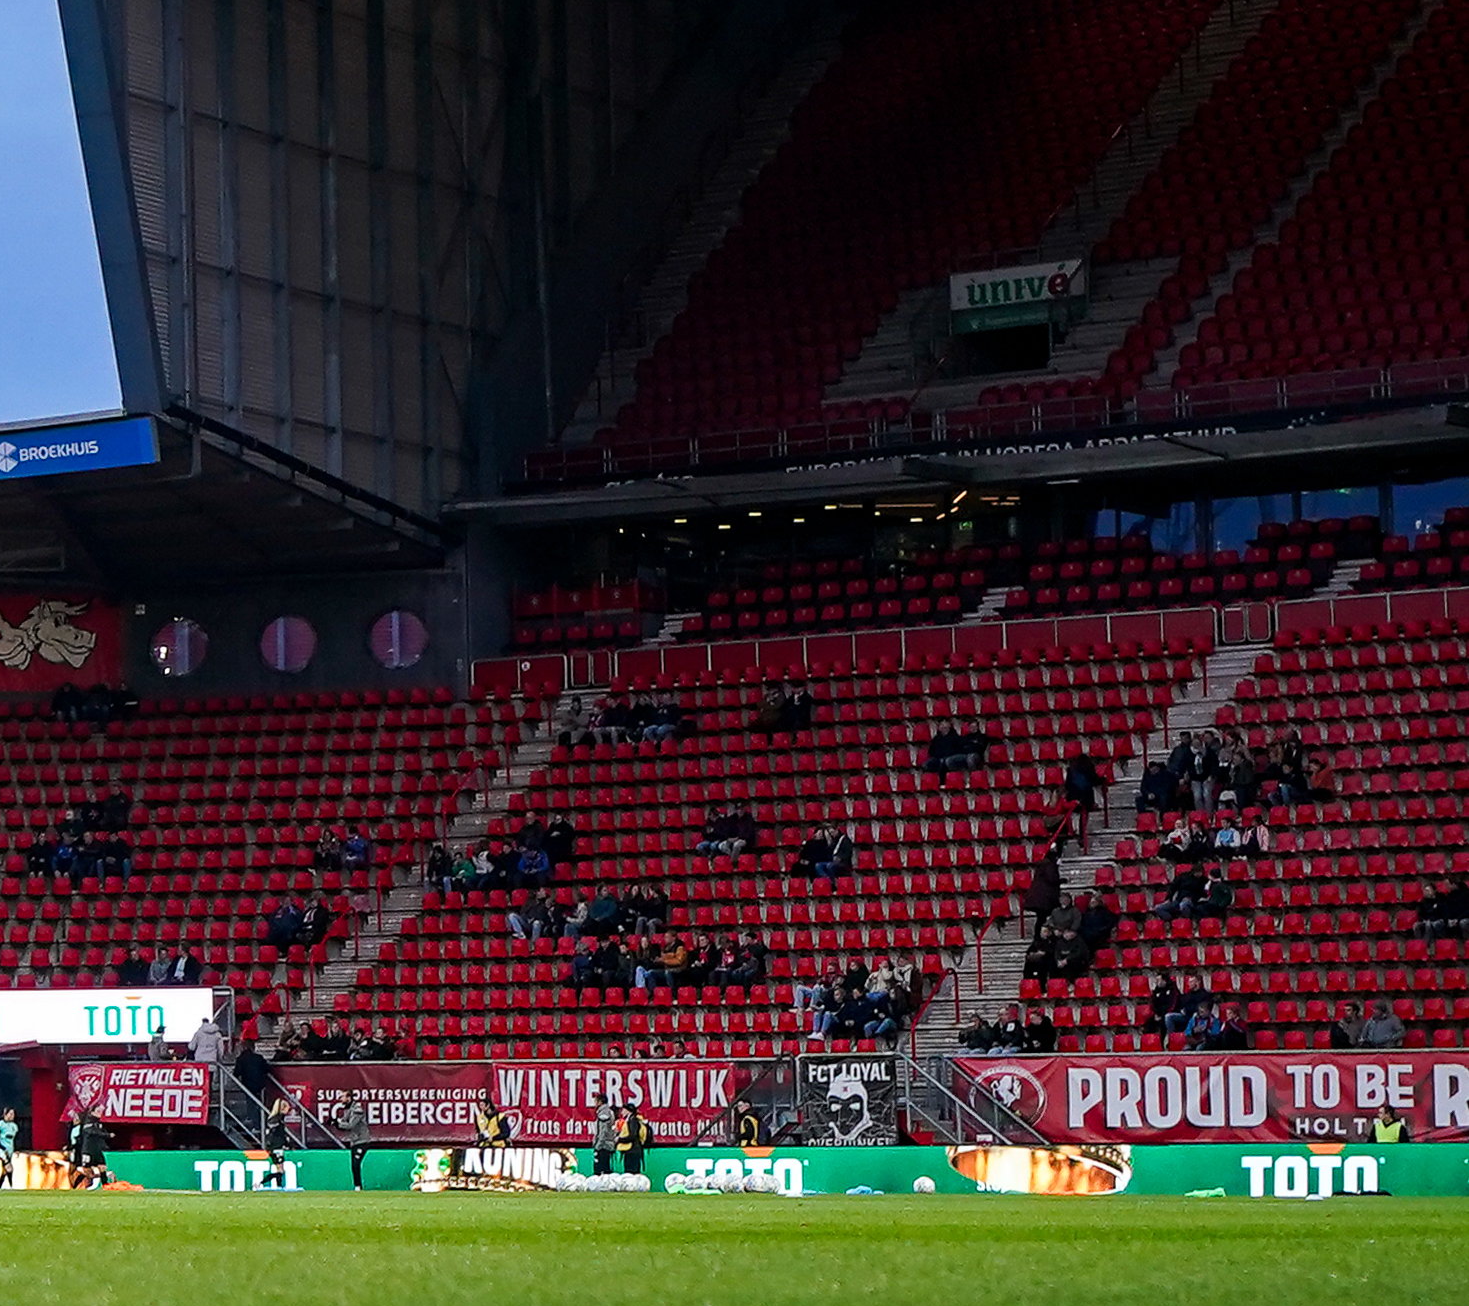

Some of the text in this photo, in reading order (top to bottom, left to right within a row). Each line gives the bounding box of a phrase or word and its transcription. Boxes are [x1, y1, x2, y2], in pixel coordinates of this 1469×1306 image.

[18, 439, 99, 462] BROEKHUIS
[83, 1005, 164, 1037] TOTO
[108, 1067, 205, 1087] RIETMOLEN
[808, 1061, 891, 1083] FCT LOYAL
[317, 1087, 487, 1101] SUPORTERSVERENIGING
[497, 1069, 730, 1109] WINTERSWIJK
[1066, 1064, 1269, 1130] PROUD
[1285, 1063, 1341, 1109] TO
[1355, 1063, 1415, 1109] BE
[105, 1087, 204, 1119] NEEDE
[317, 1102, 482, 1125] FC EIBERGEN
[526, 1118, 560, 1136] Trots
[1240, 1155, 1379, 1198] TOTO
